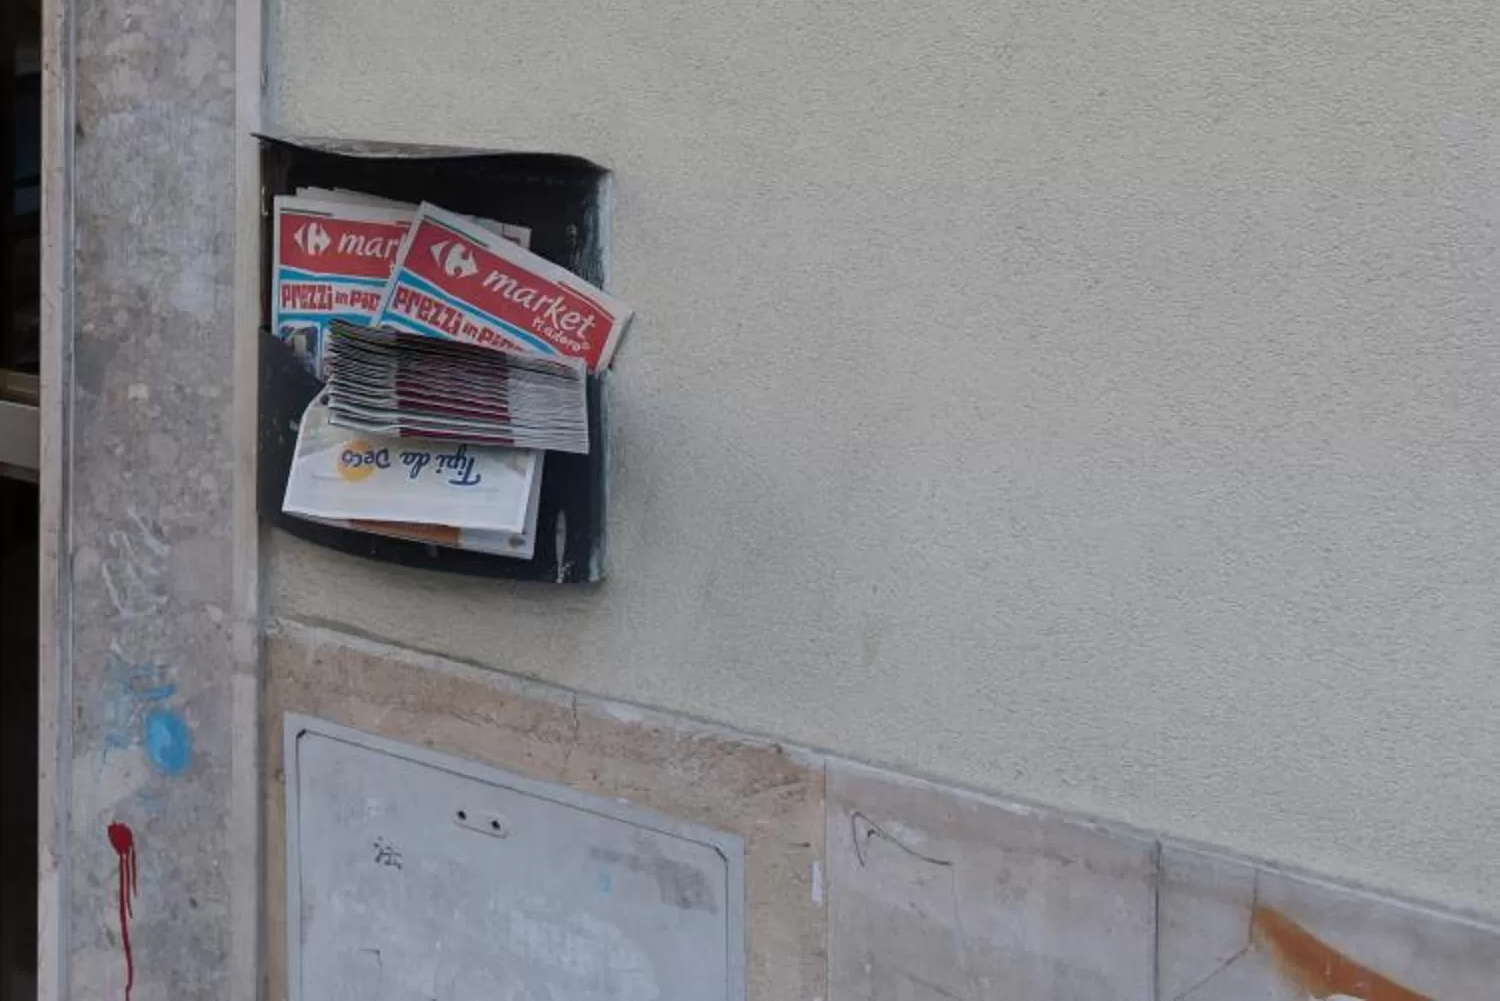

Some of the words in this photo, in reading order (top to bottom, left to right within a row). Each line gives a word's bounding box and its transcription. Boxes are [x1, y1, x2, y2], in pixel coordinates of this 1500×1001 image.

[482, 270, 596, 340] market
[400, 451, 431, 479] da
[435, 442, 481, 486] Tipi
